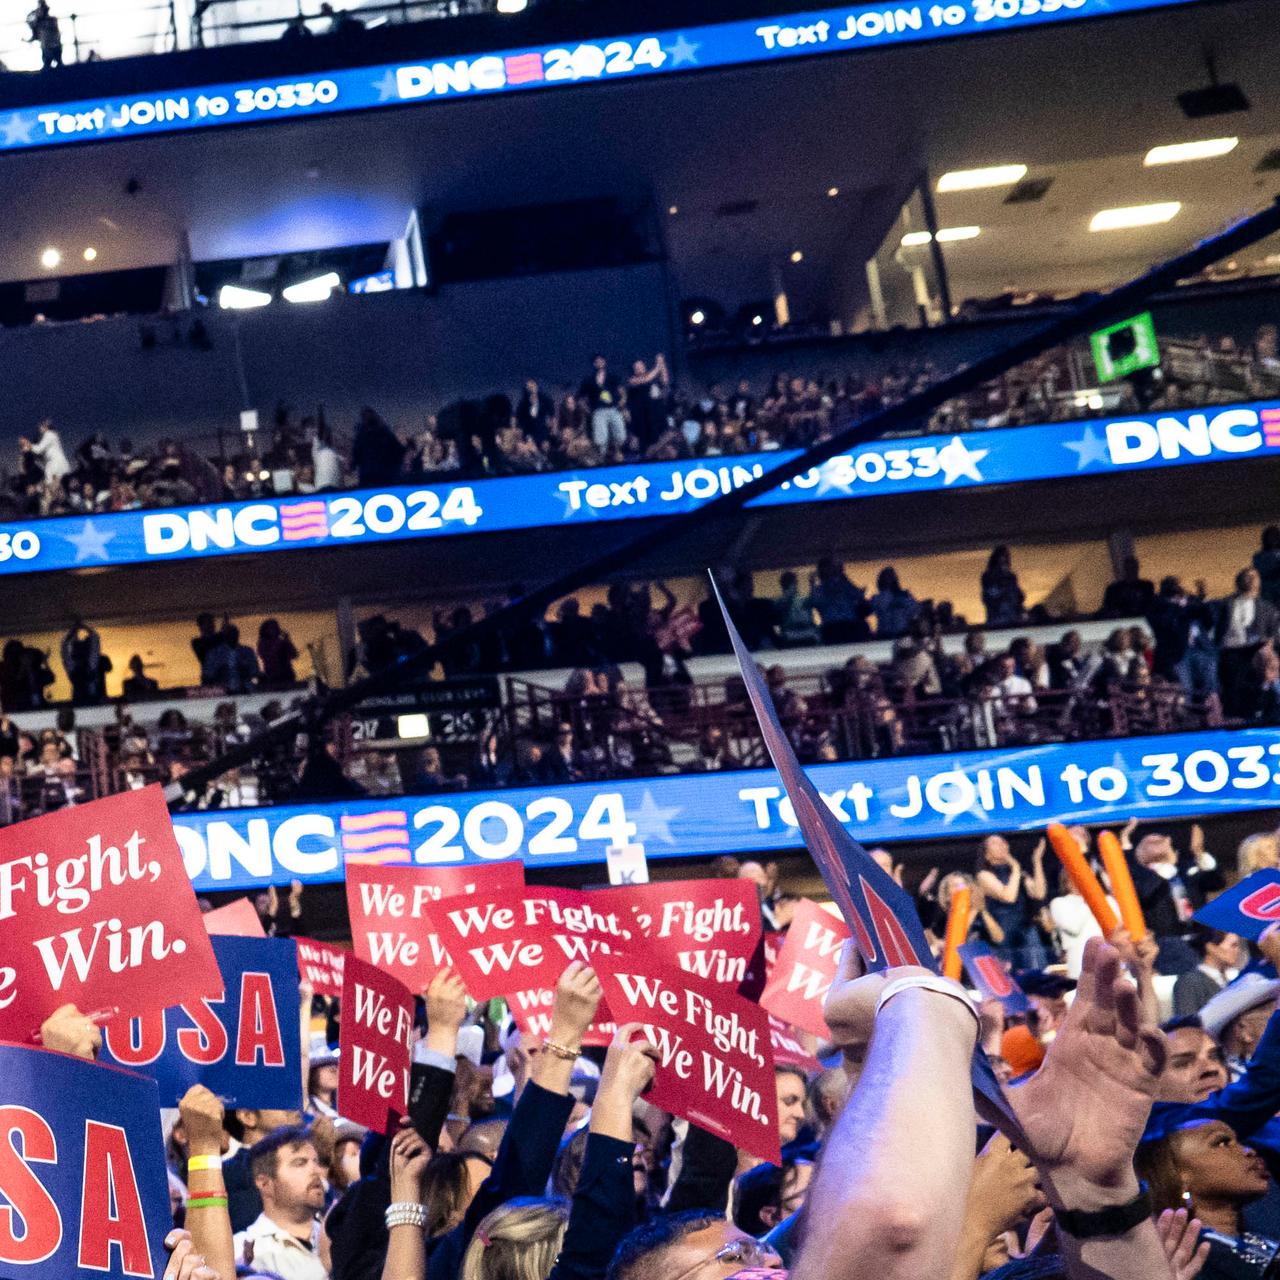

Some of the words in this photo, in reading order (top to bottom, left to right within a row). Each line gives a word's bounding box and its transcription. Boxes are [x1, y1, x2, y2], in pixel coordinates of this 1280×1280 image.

[756, 20, 831, 51] Text
[837, 6, 921, 41] JOIN
[929, 4, 965, 28] to
[396, 58, 507, 100] DNC
[544, 37, 666, 81] 2024
[38, 109, 107, 136] Text
[111, 96, 190, 129] JOIN
[195, 92, 229, 119] to
[234, 80, 338, 114] 30330
[1104, 409, 1264, 466] DNC
[559, 475, 650, 510] Text
[779, 466, 820, 492] o
[143, 503, 281, 556] DNC
[327, 486, 482, 539] 2024
[890, 765, 1046, 819] JOIN
[1060, 764, 1129, 804] to
[412, 793, 637, 865] 2024
[359, 882, 407, 918] We
[447, 903, 516, 939] We
[523, 898, 632, 943] Fight,
[658, 897, 752, 944] Fight,
[33, 917, 188, 994] Win.
[366, 931, 420, 968] We
[468, 938, 544, 977] We
[104, 970, 287, 1068] USA
[355, 982, 393, 1036] We
[516, 987, 554, 1011] We
[614, 971, 679, 1016] We
[682, 987, 765, 1068] Fight,
[351, 1045, 397, 1099] We
[642, 1023, 694, 1080] We
[700, 1051, 770, 1129] Win.
